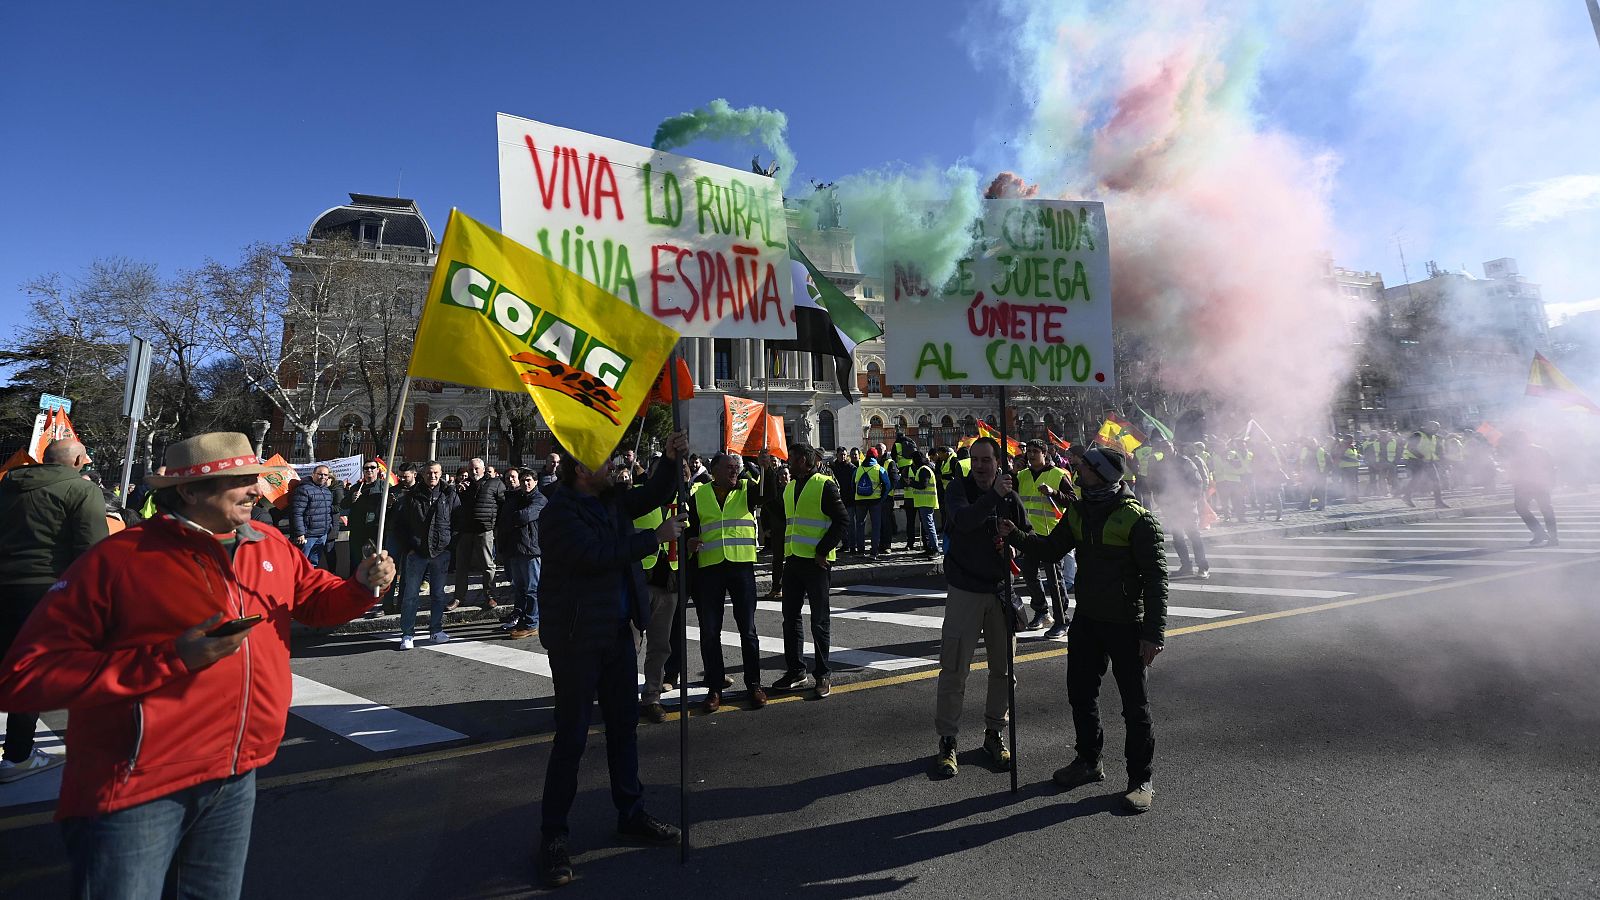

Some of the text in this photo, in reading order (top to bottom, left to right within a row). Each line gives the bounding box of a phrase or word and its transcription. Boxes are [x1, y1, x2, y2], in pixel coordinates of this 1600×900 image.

[524, 134, 786, 249] VIVA LO RURAL
[1002, 207, 1095, 251] COMIDA
[651, 243, 797, 327] ESPAÑA.
[991, 255, 1091, 301] JUEGA
[450, 267, 626, 389] COAG
[967, 291, 1067, 343] ÚNETE
[914, 339, 1105, 383] AL CAMPO.
